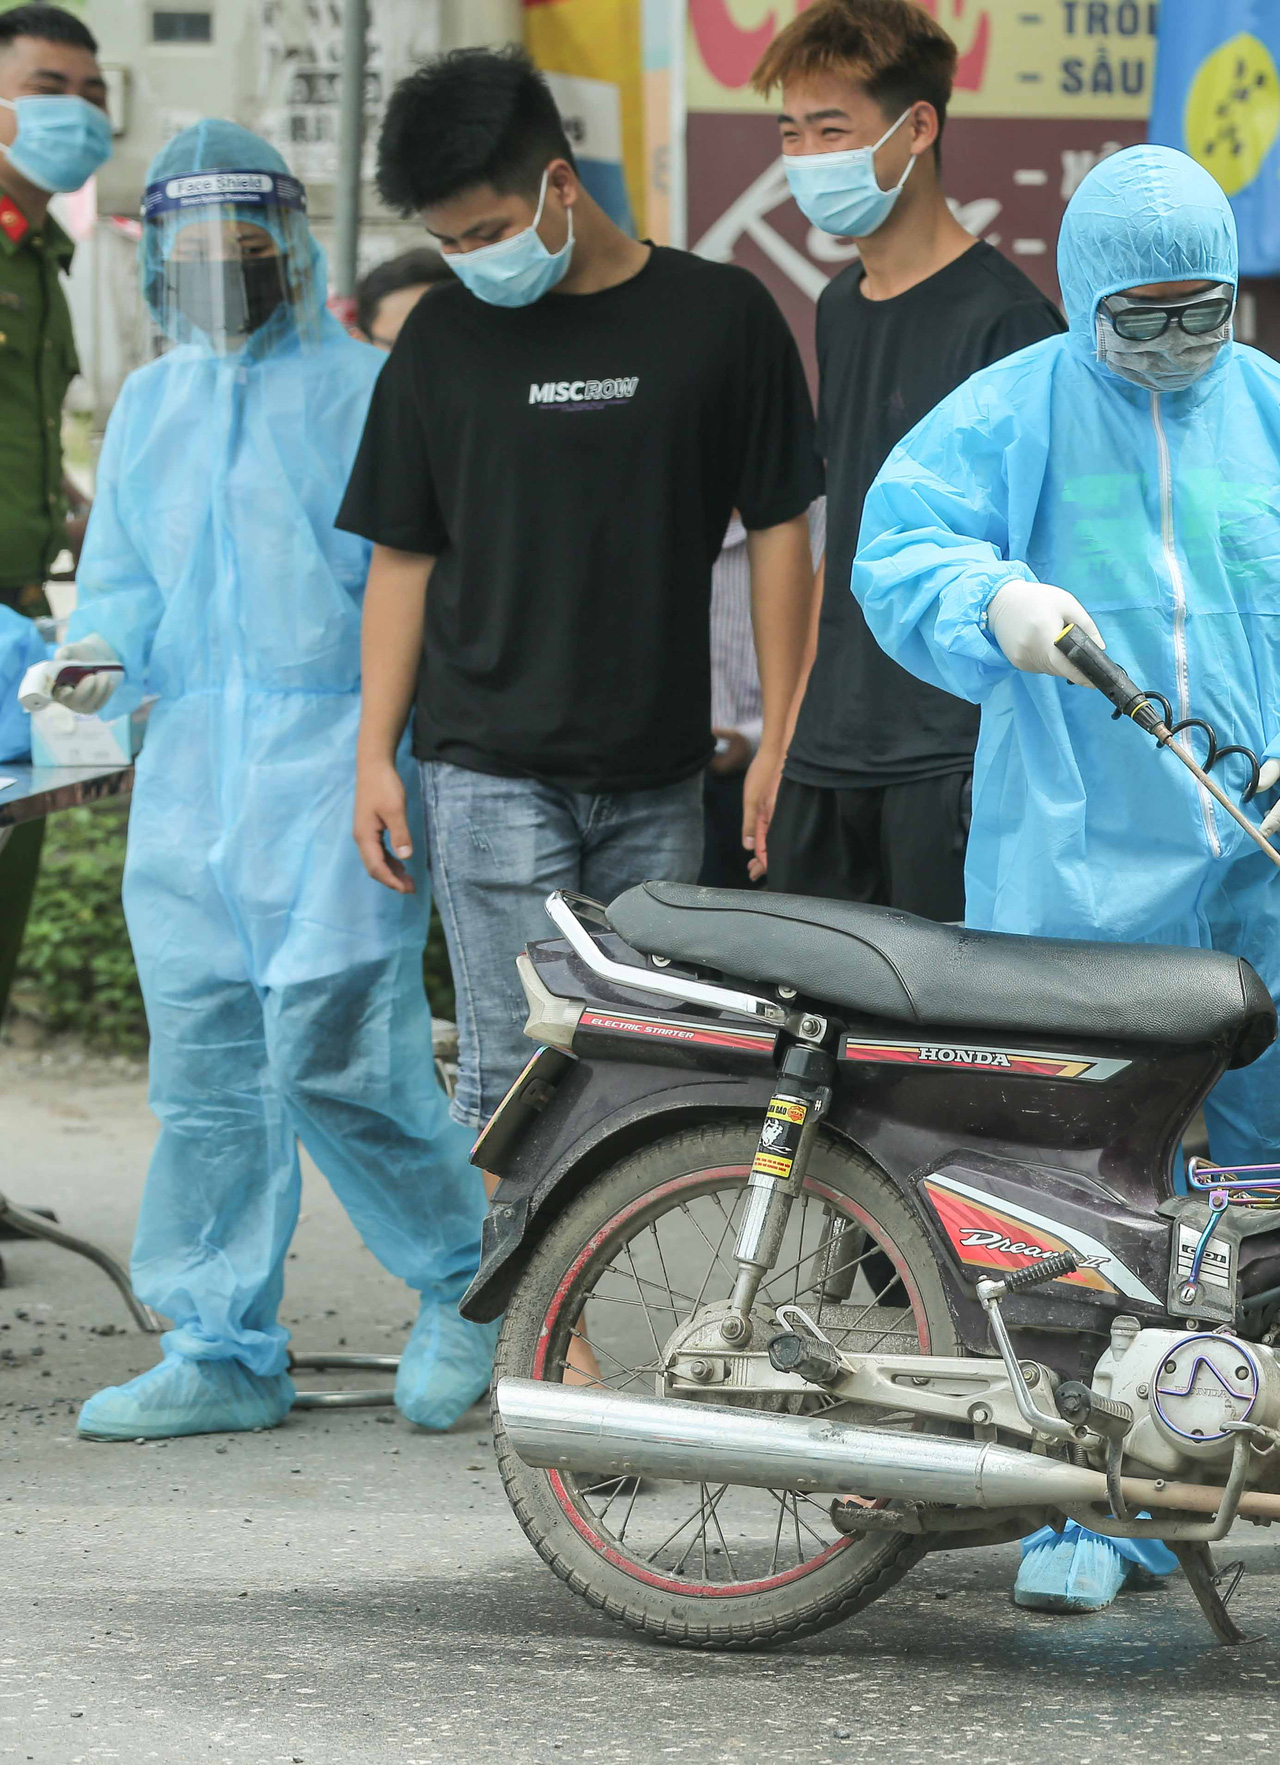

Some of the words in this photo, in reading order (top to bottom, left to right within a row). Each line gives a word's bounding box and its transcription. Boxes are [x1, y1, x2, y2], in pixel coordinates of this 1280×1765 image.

[216, 175, 263, 190] Shield
[528, 376, 640, 405] MISCROW
[591, 1018, 642, 1031] ELECTRIC
[643, 1026, 695, 1039] STARTER
[918, 1047, 1011, 1067] HONDA
